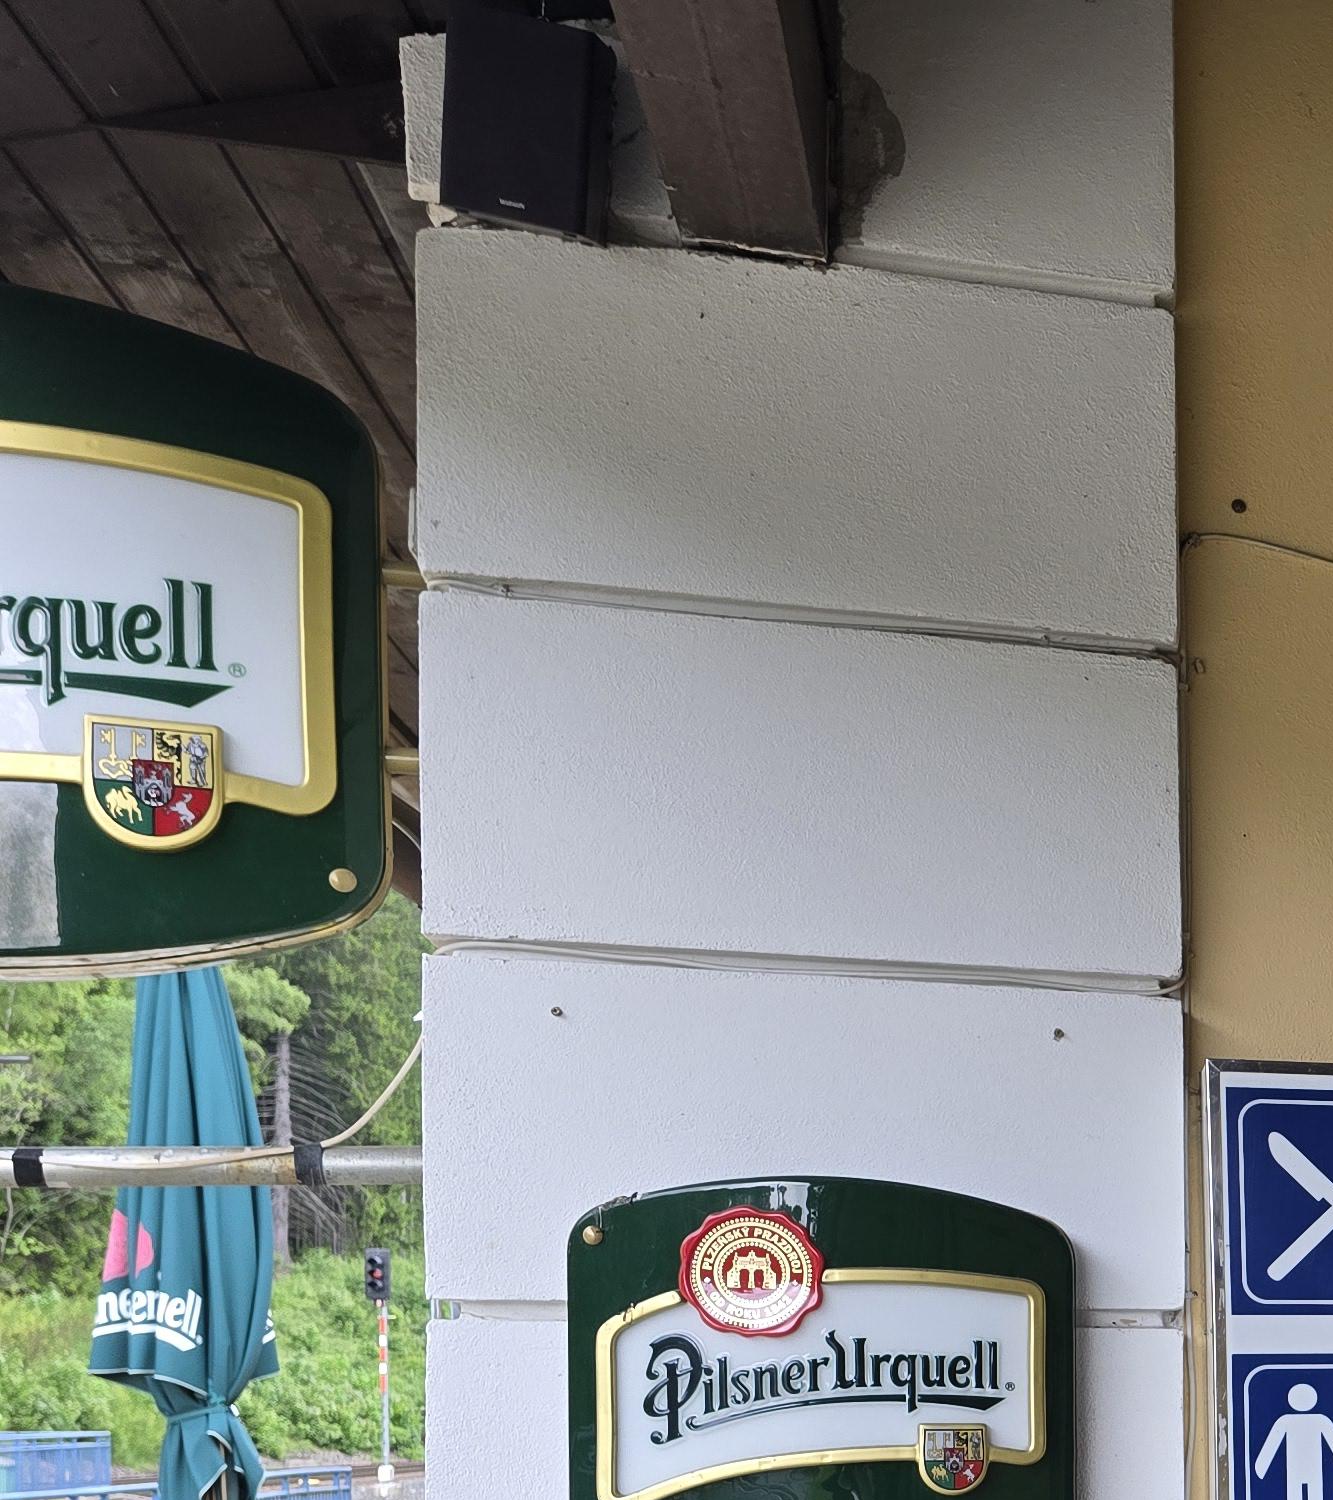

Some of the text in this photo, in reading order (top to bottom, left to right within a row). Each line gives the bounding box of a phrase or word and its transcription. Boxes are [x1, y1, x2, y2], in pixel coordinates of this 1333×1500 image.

[753, 1227, 803, 1274] PRAZDROJ
[643, 1329, 1001, 1445] Pilsner Urquell
